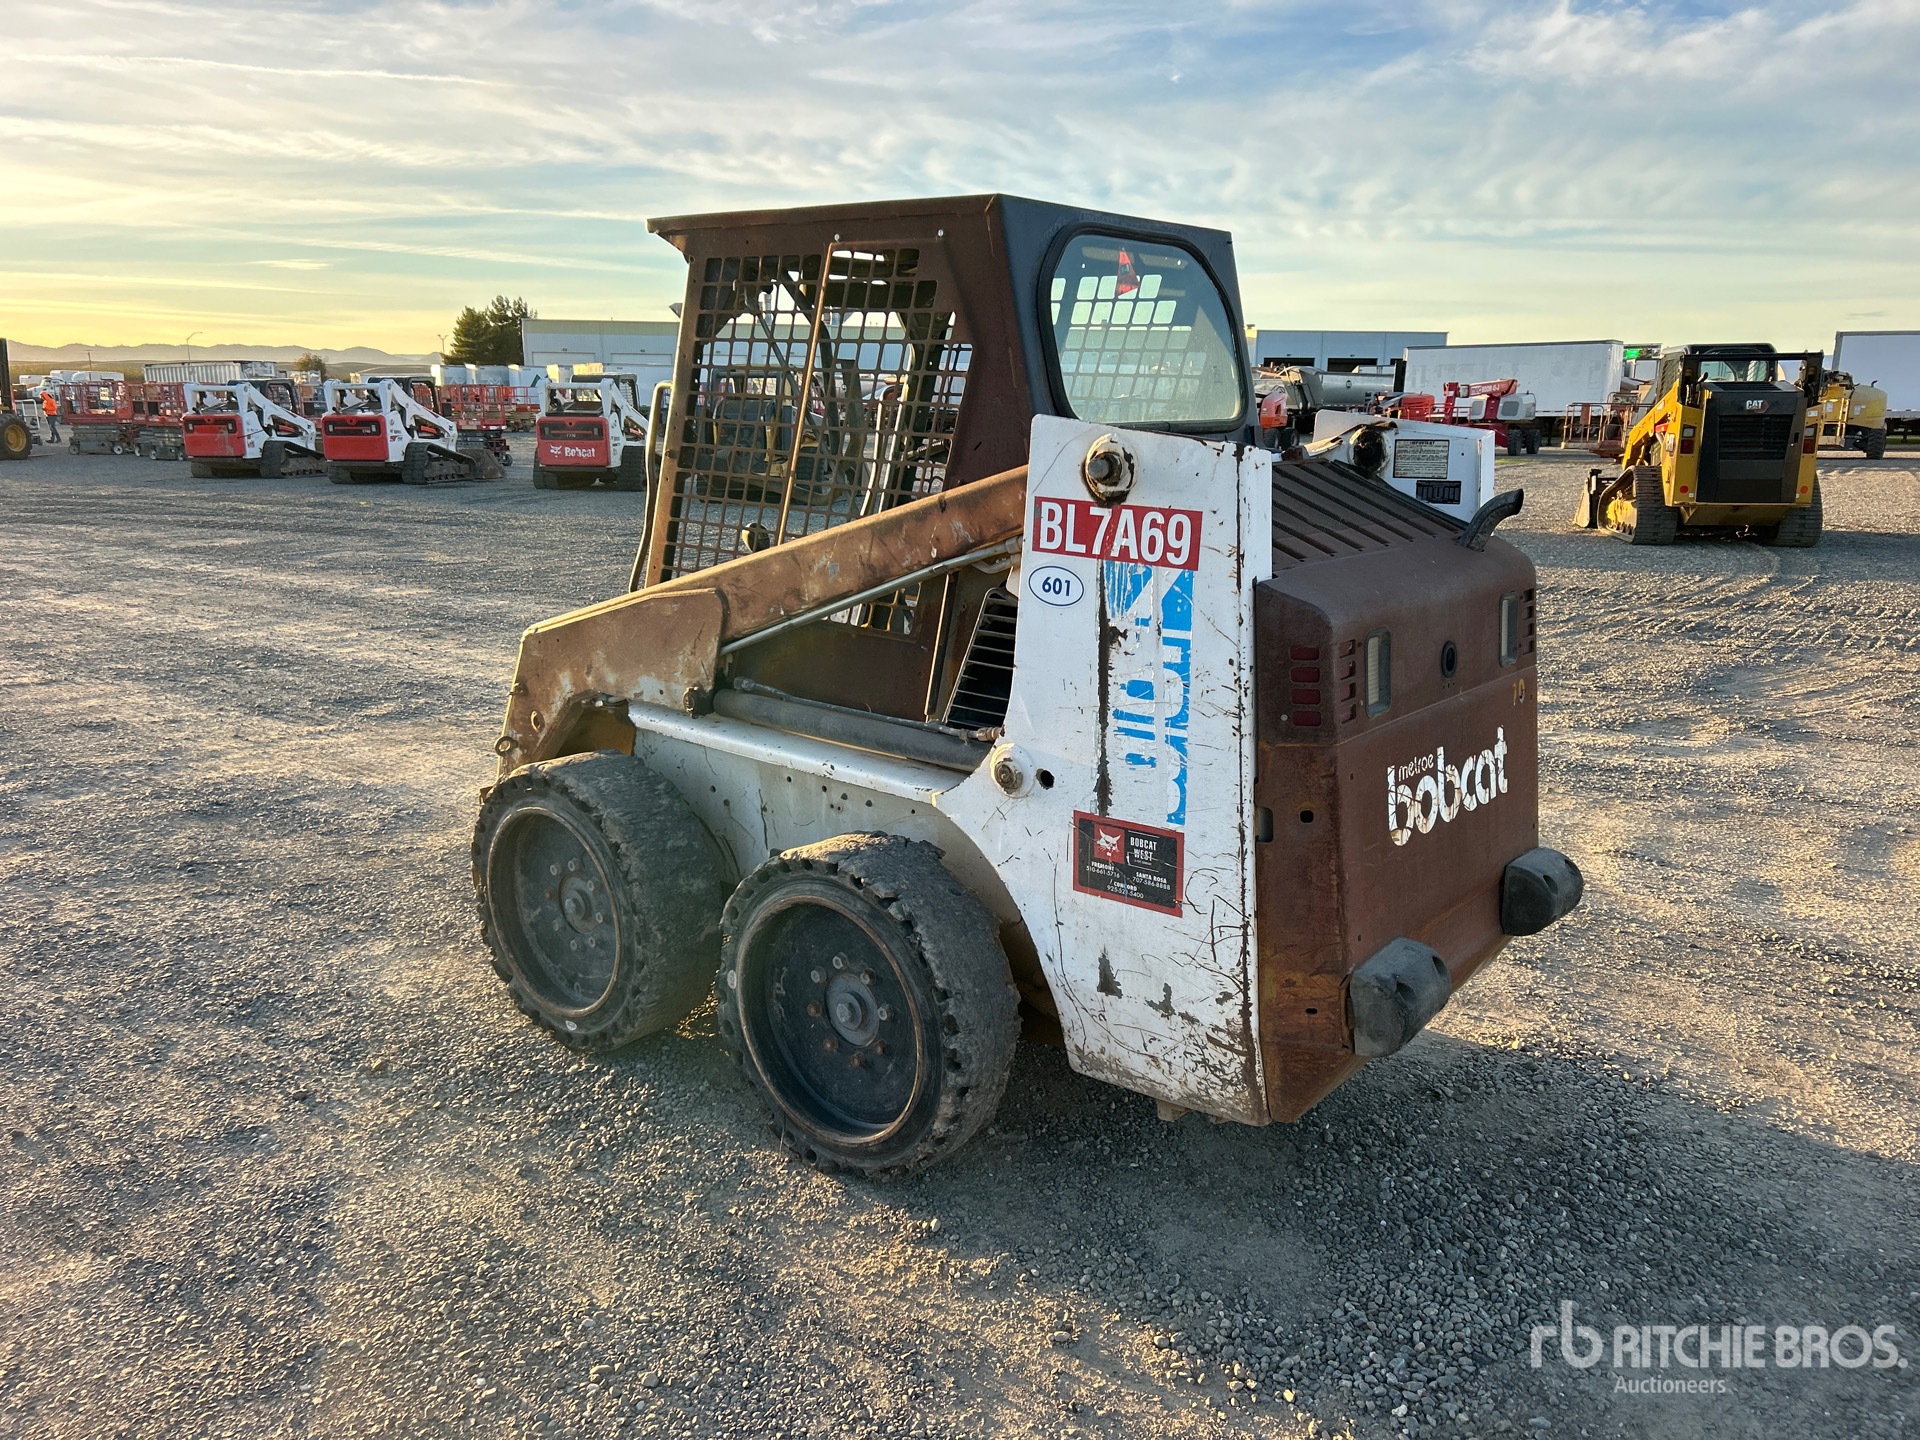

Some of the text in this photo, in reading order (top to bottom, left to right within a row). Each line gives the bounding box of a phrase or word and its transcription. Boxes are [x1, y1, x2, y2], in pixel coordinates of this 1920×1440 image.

[1746, 400, 1763, 409] CAT
[564, 446, 596, 458] Bobcat
[1039, 501, 1191, 566] BL7A69
[1042, 576, 1071, 597] 601
[1387, 725, 1508, 847] bobcat
[1130, 836, 1157, 851] BOBCAT
[1133, 848, 1153, 861] WEST
[1091, 861, 1115, 871] FREMONT
[1136, 872, 1167, 884] SANTA ROSA
